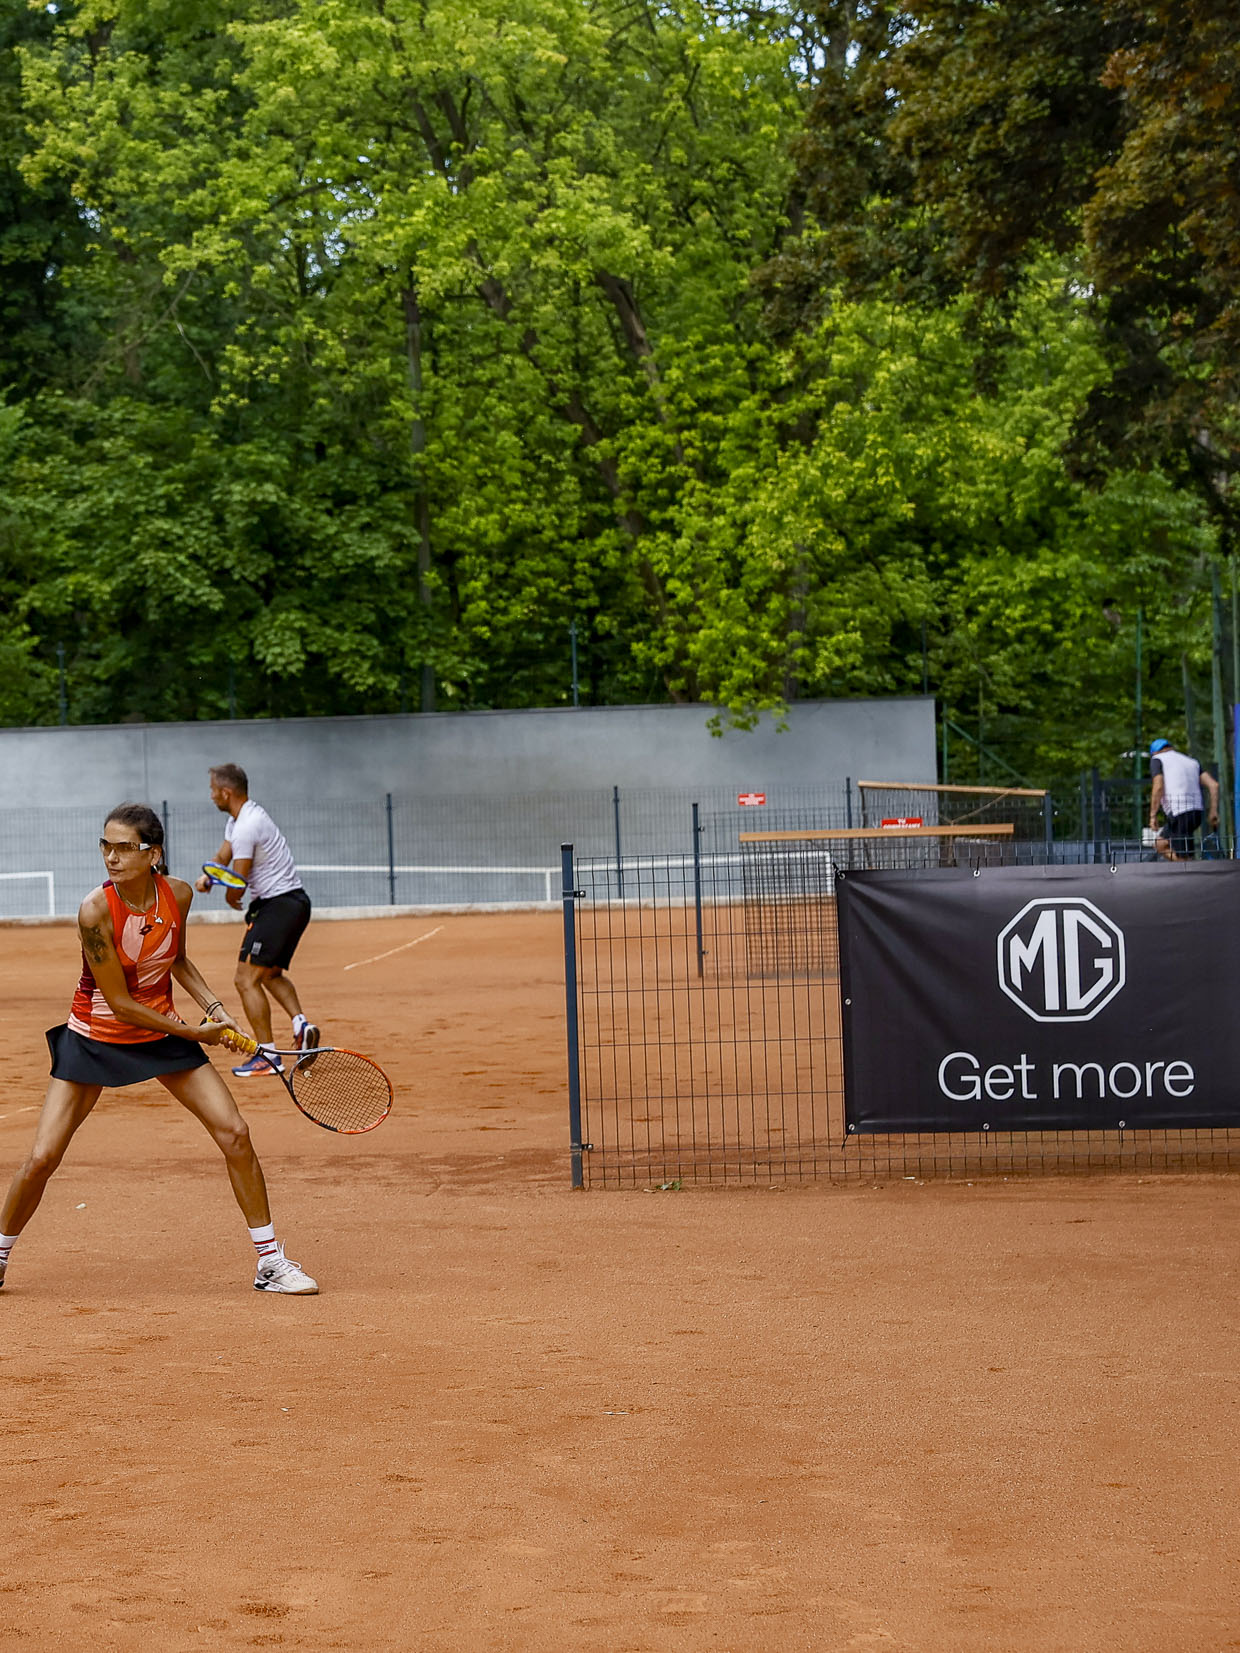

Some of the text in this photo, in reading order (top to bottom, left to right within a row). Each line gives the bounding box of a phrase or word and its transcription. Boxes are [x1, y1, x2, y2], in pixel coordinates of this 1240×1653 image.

[1009, 909, 1113, 1011] MG
[938, 1051, 1195, 1101] Get more
